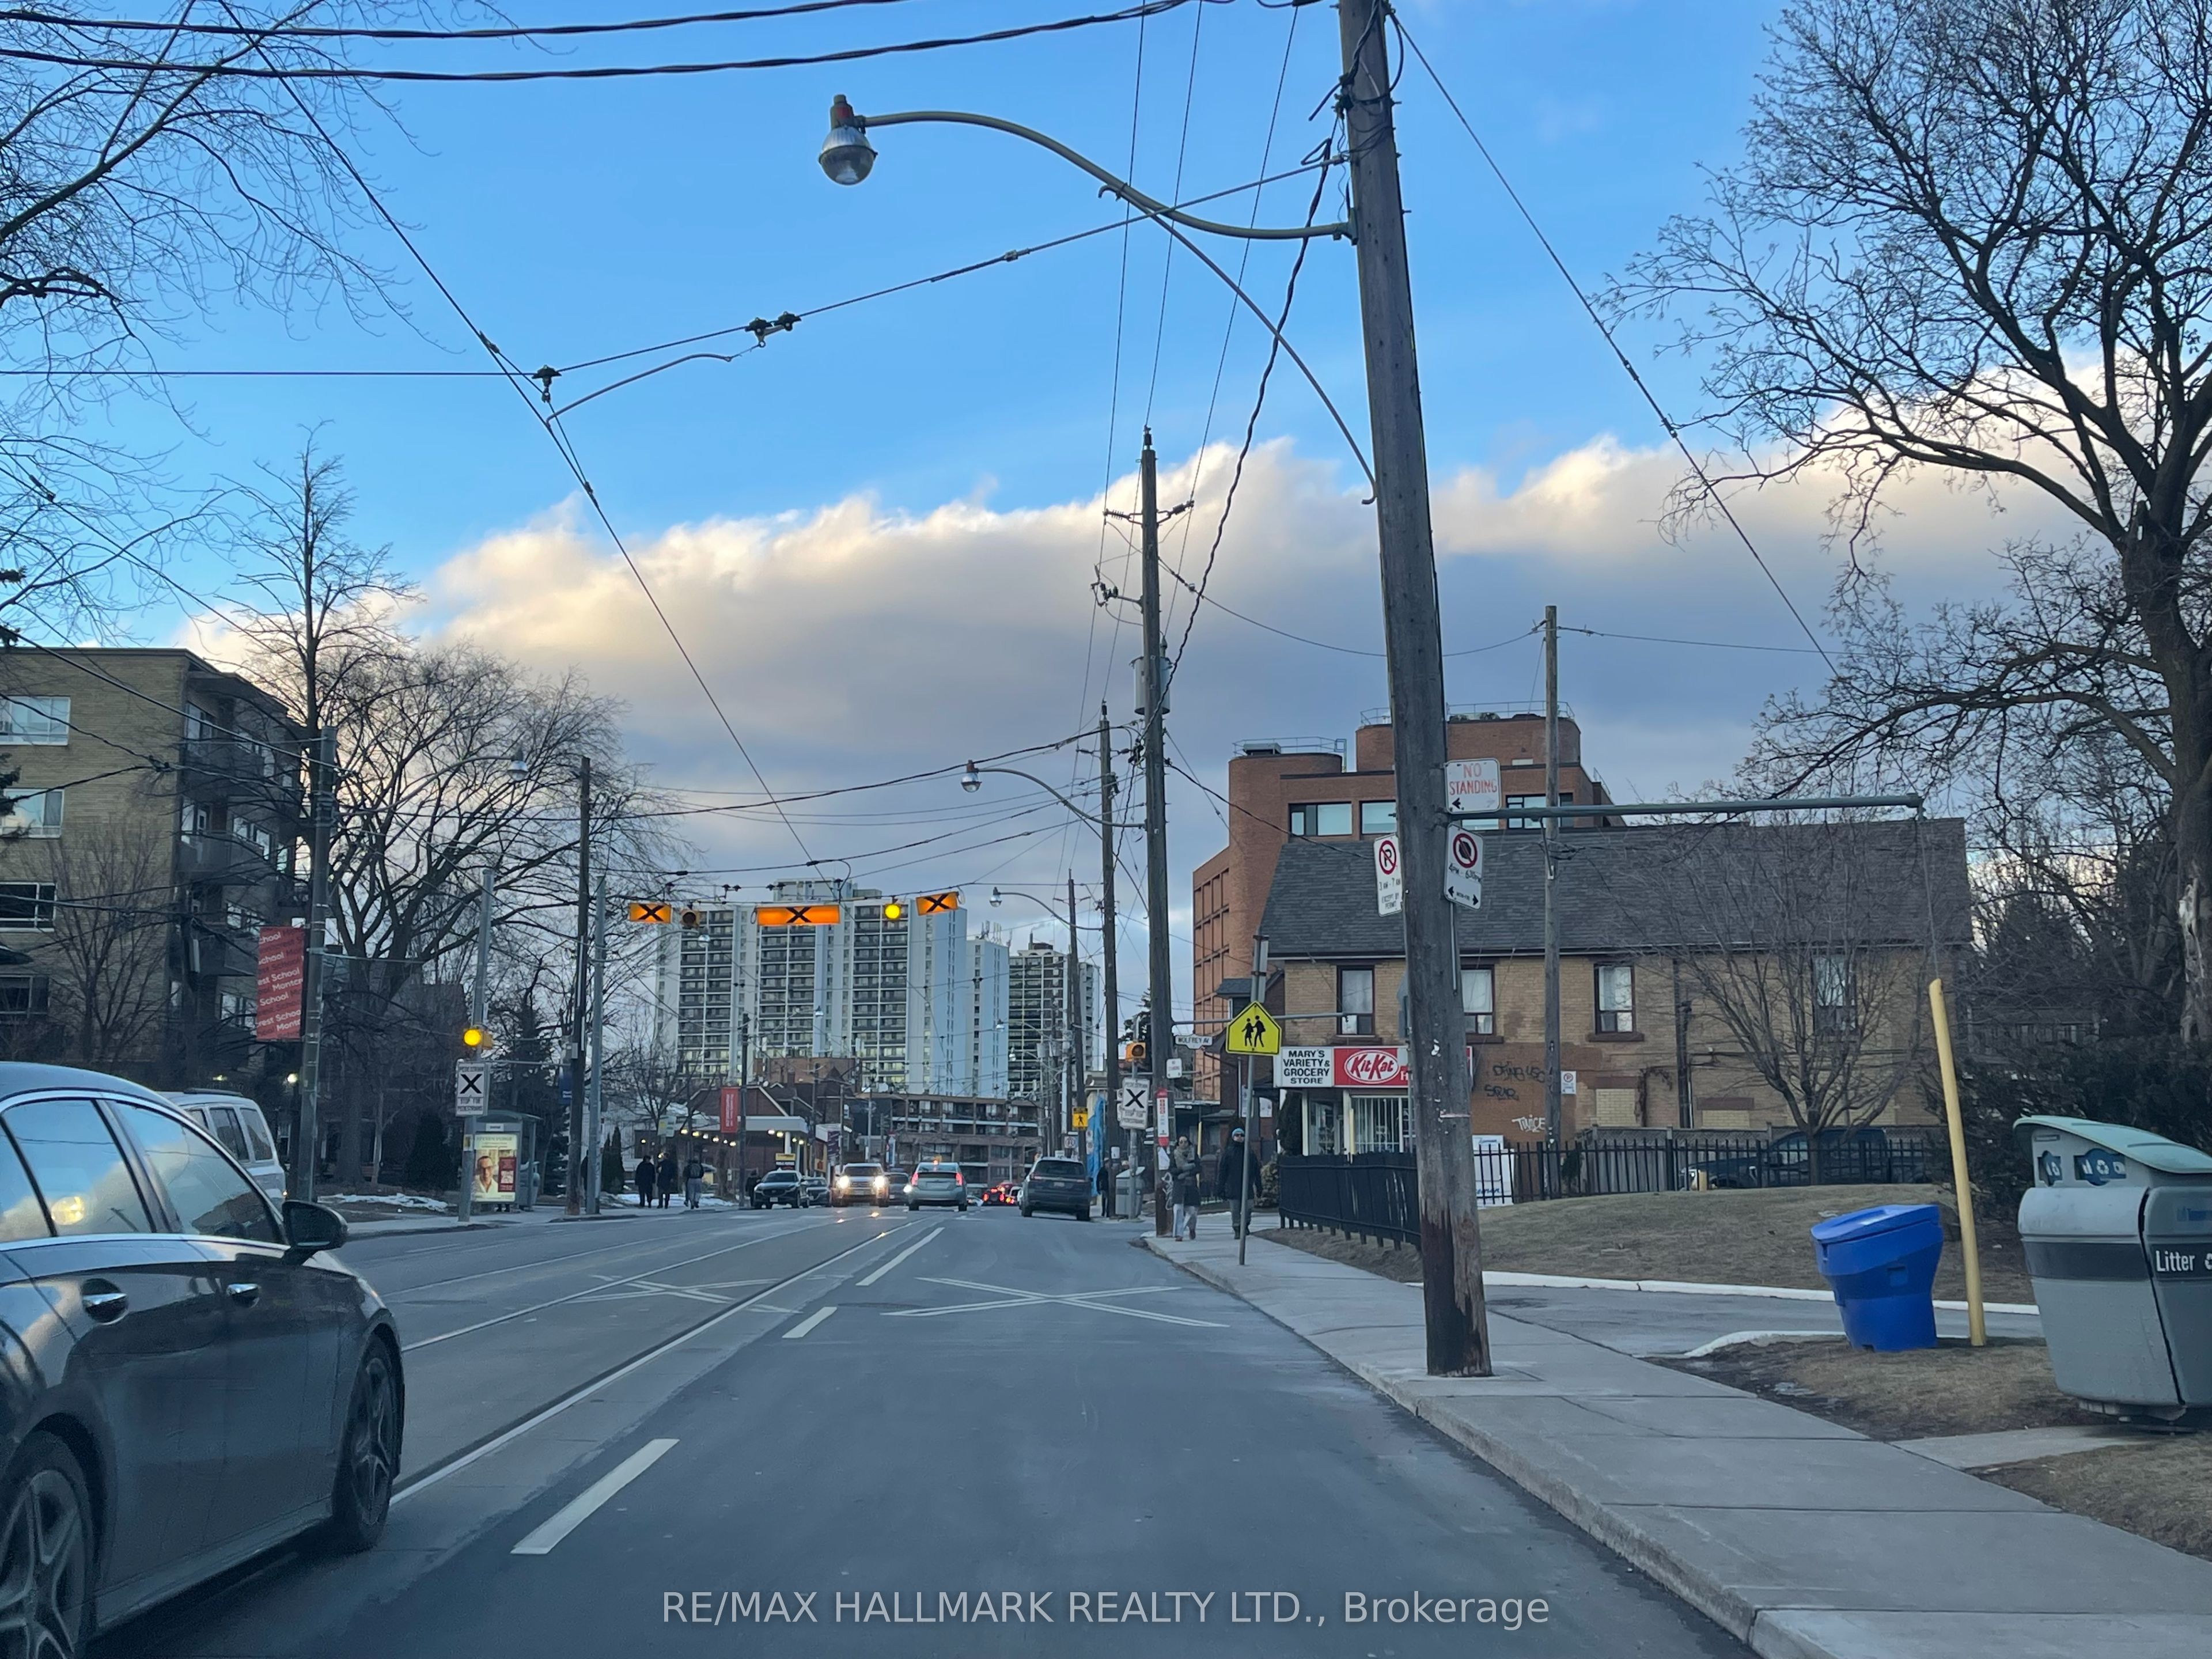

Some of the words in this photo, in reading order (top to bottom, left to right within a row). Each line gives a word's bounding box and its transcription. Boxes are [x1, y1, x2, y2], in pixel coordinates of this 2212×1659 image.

[1464, 763, 1482, 778] NO
[1449, 779, 1497, 796] STANDING
[271, 967, 300, 982] School
[260, 991, 289, 1006] School
[1289, 1049, 1325, 1058] MARY'S
[1283, 1059, 1324, 1067] VARIETY
[1283, 1068, 1330, 1077] GROCERY
[2156, 1251, 2195, 1272] Litter
